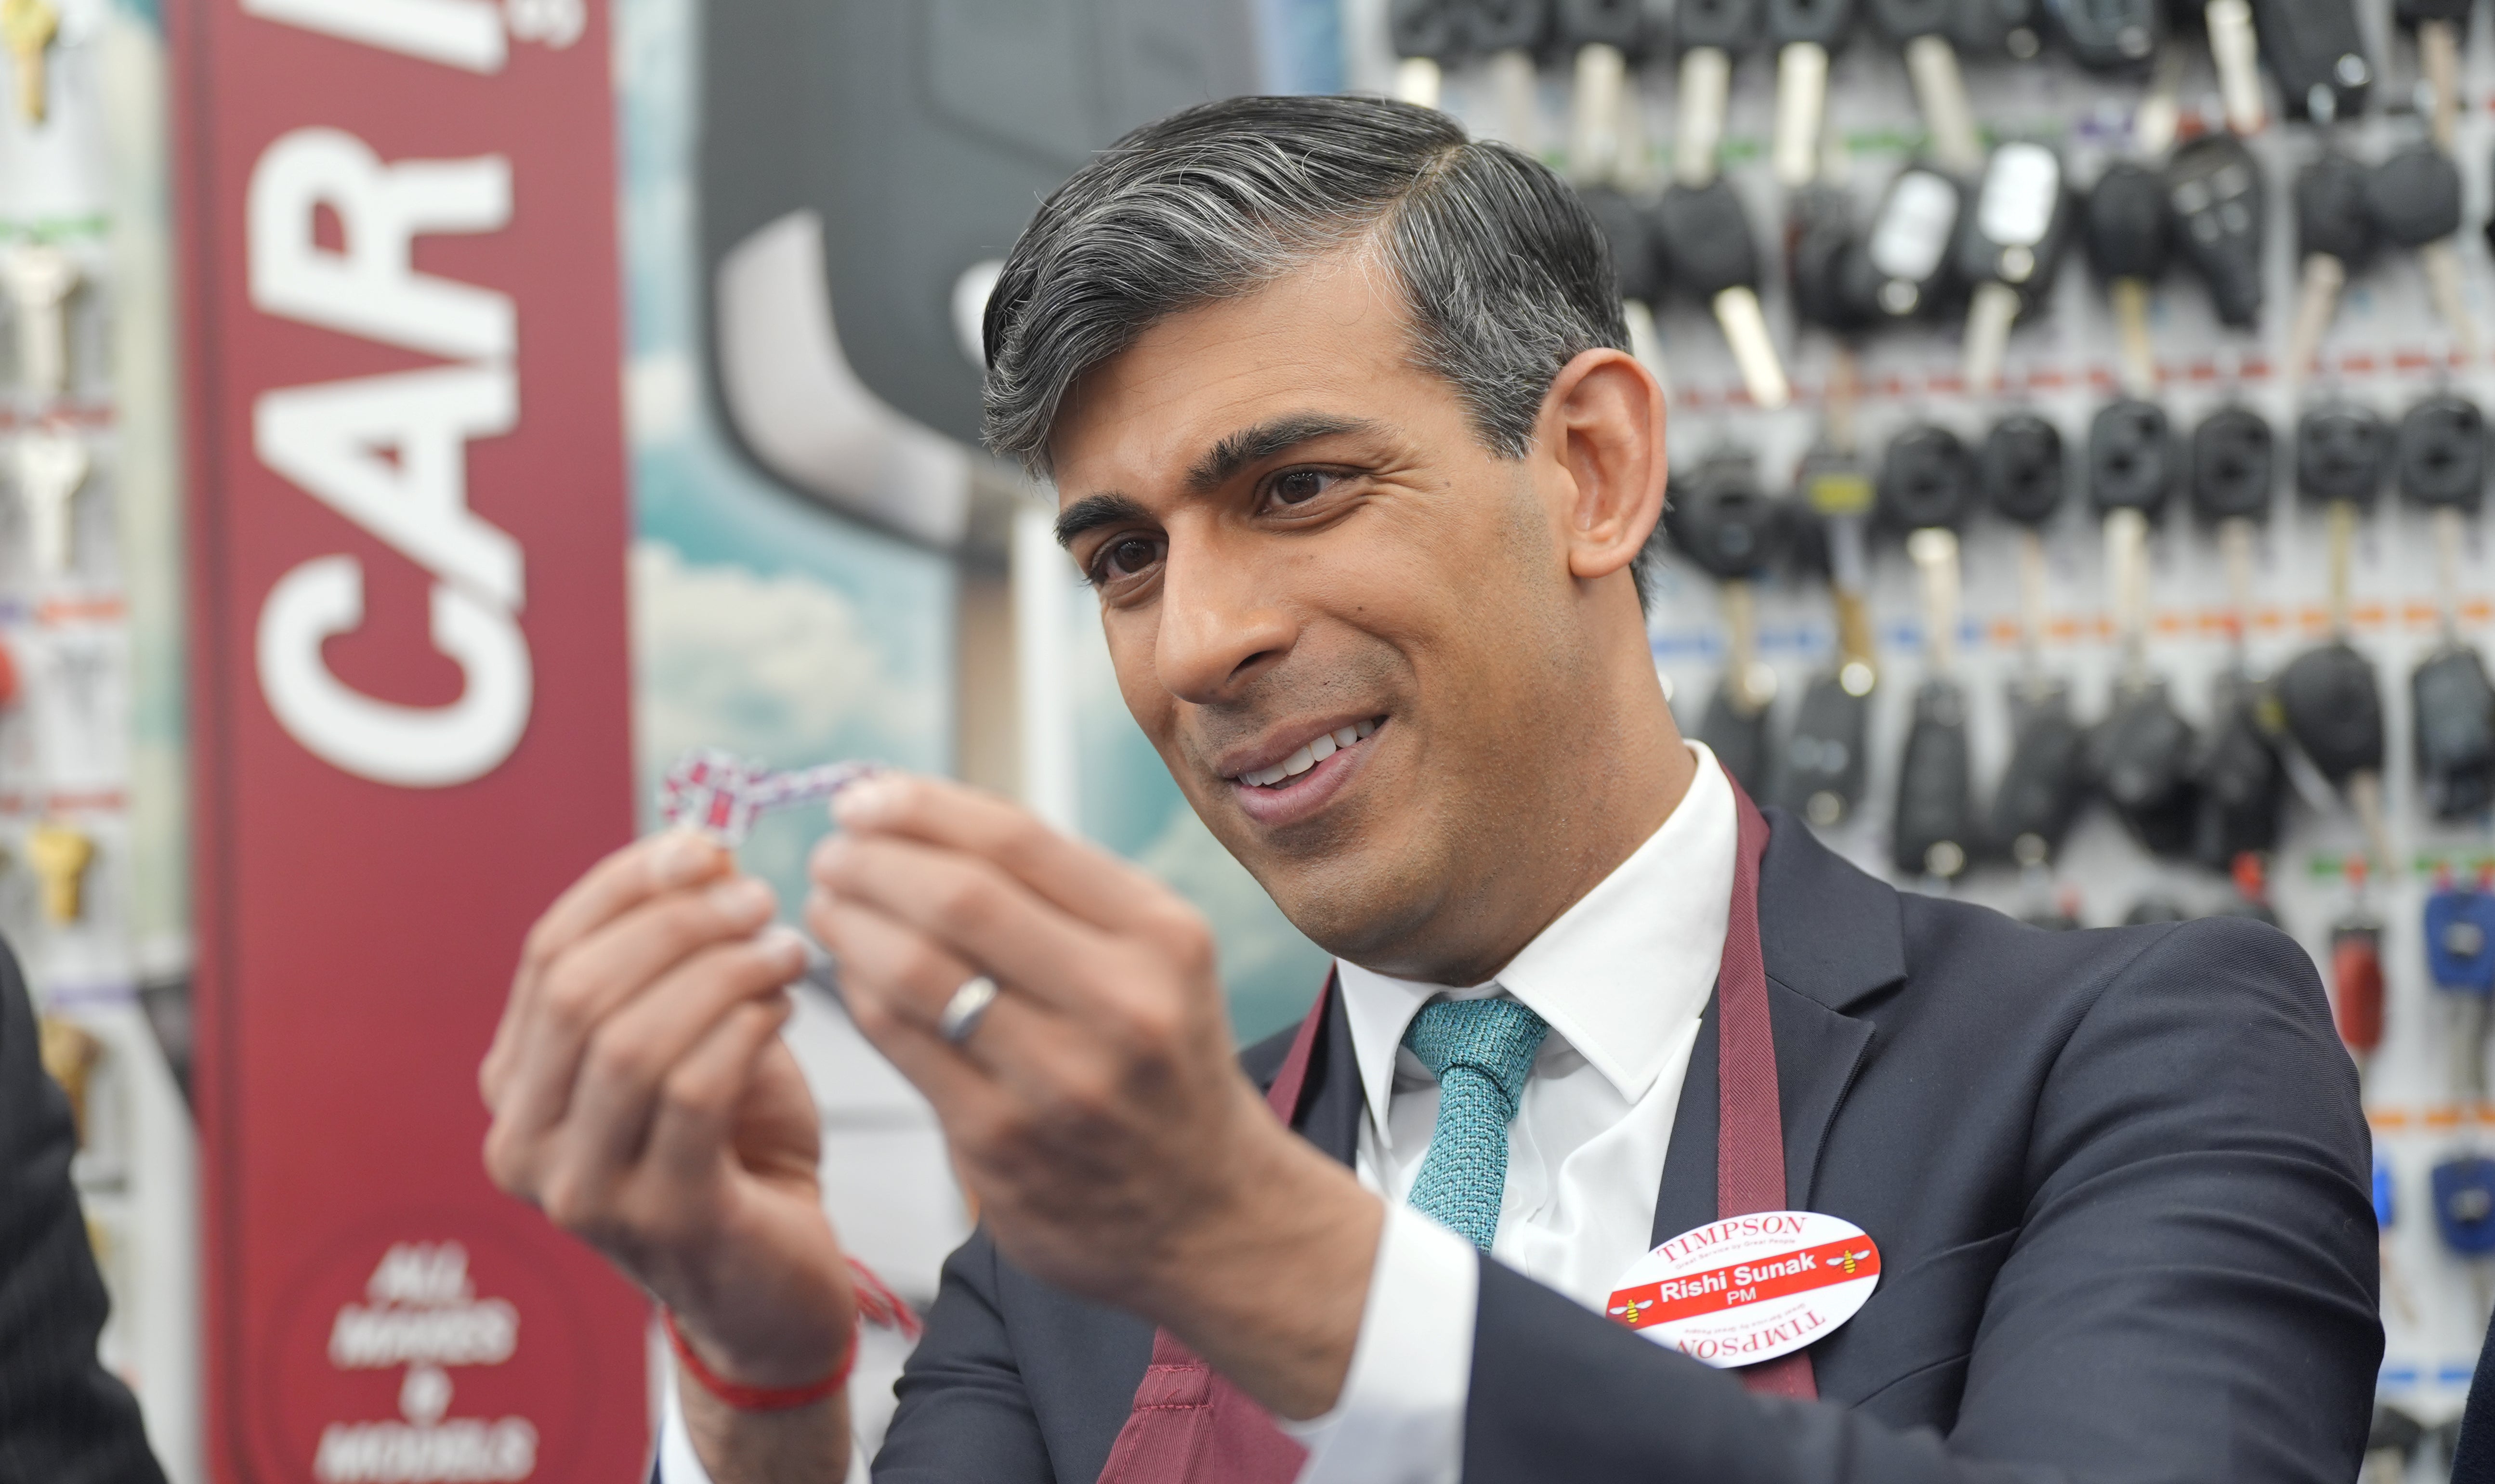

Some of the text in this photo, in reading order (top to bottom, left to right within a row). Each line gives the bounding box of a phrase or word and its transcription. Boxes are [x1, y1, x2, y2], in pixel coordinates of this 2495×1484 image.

[245, 128, 533, 788] CAR
[1657, 1216, 1807, 1263] TIMPSON
[1676, 1258, 1697, 1270] Great
[1699, 1247, 1729, 1260] Service
[1730, 1242, 1742, 1250] by
[1743, 1238, 1767, 1247] Great
[1660, 1251, 1817, 1303] Rishi Sunak
[1726, 1287, 1757, 1305] PM
[1676, 1311, 1825, 1359] TIMPSON
